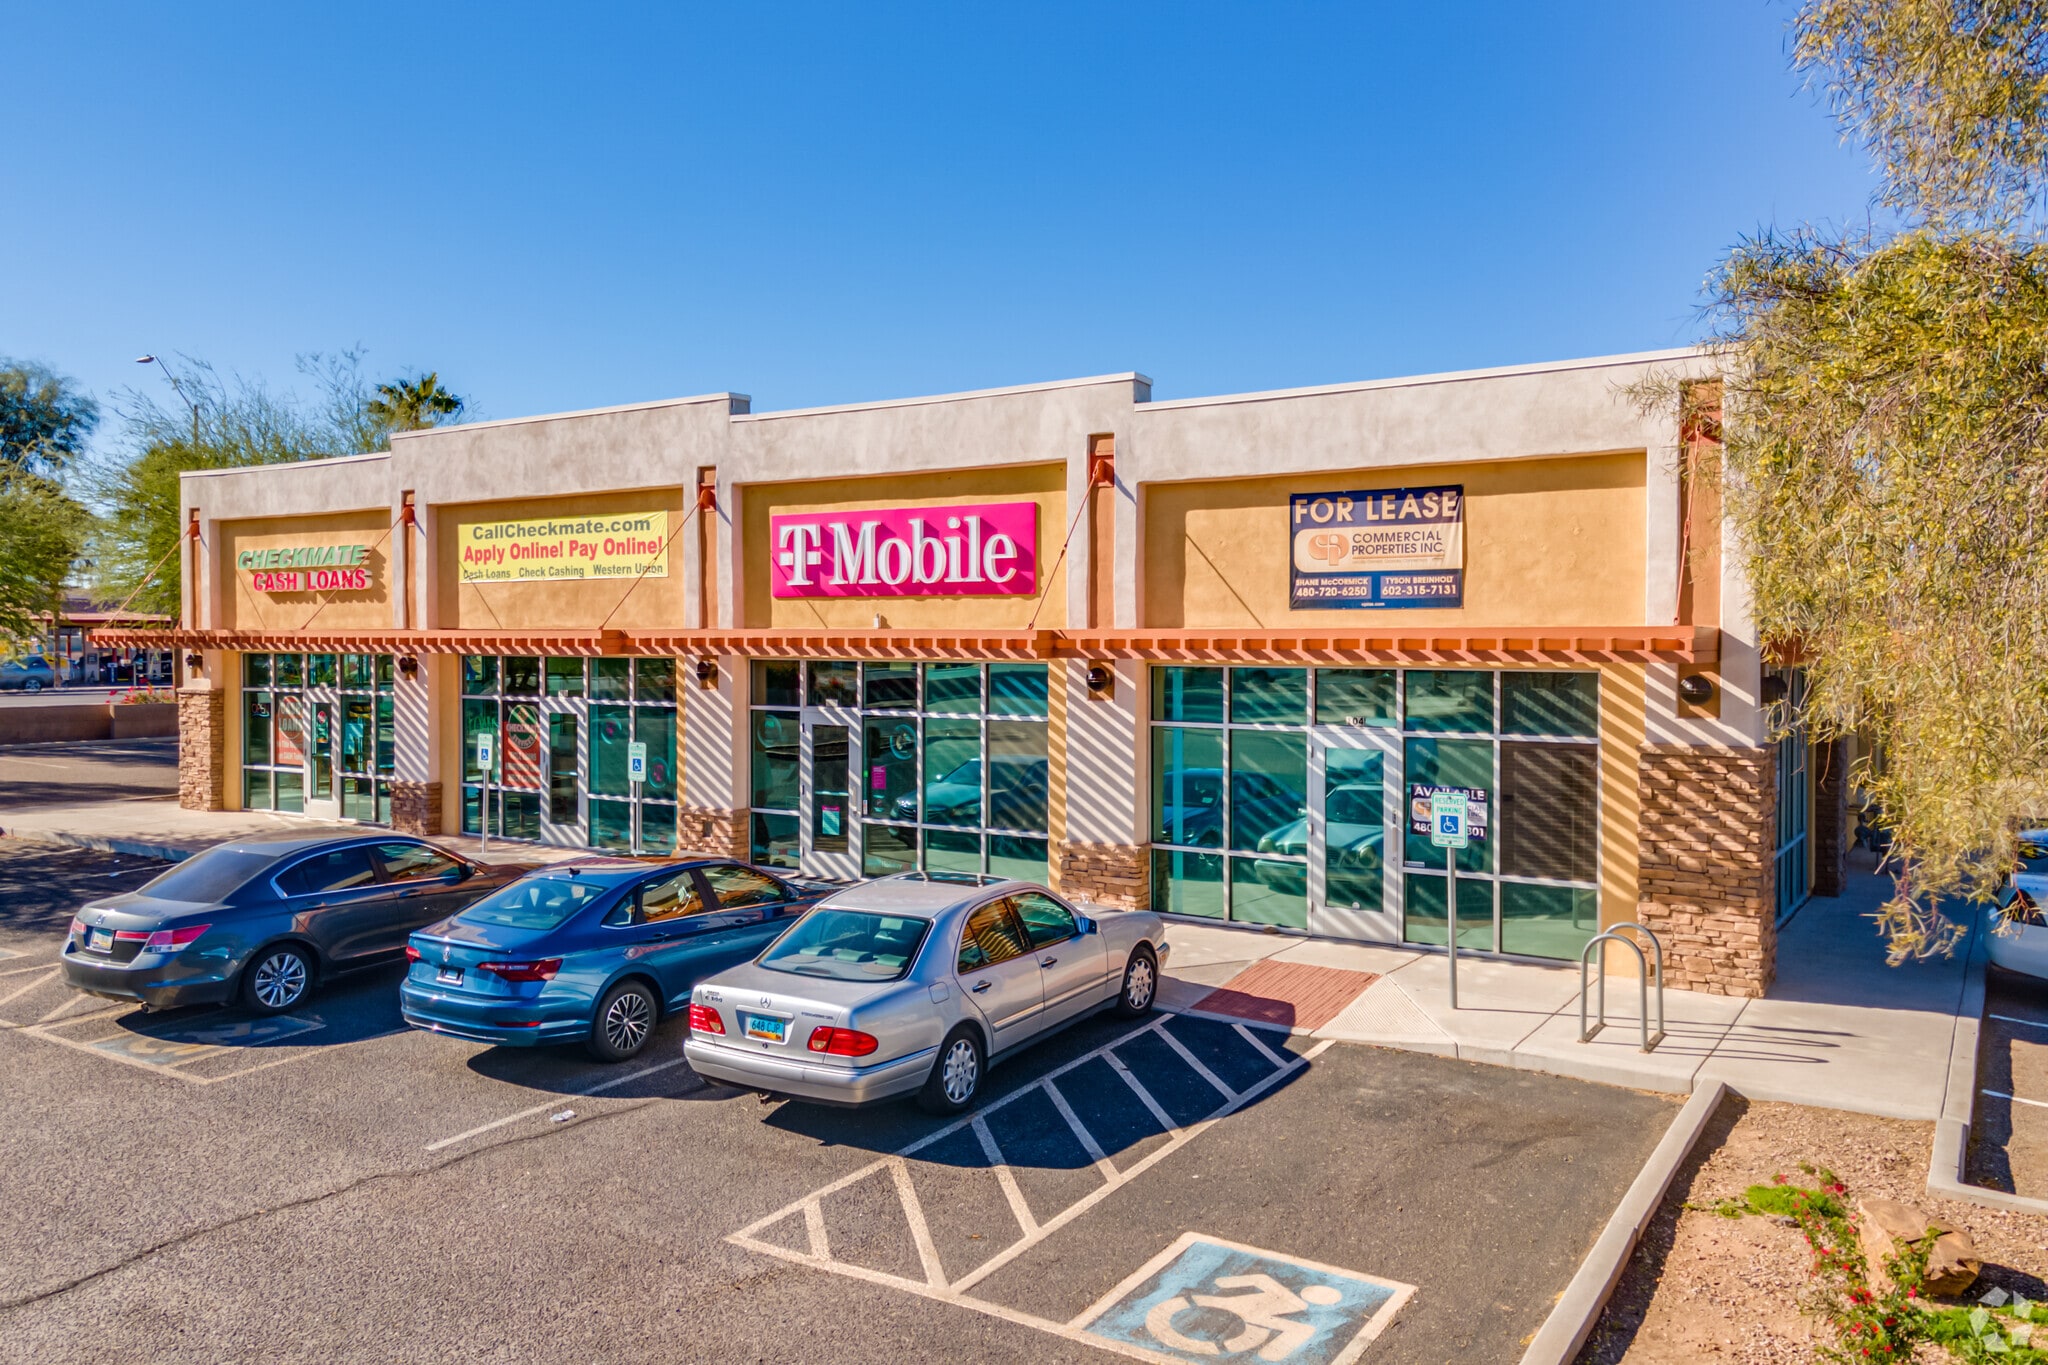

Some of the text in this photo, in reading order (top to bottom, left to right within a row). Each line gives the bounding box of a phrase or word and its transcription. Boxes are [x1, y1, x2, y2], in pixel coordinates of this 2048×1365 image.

[1295, 491, 1457, 523] FOR LEASE
[472, 519, 651, 540] CallCheckmate.com
[1352, 531, 1442, 543] COMMERCIAL
[463, 536, 663, 565] Apply Online! Pay Online!
[1351, 543, 1417, 555] PROPERTIES
[237, 544, 367, 571] CHECKMATE
[463, 563, 663, 579] Cash Loans Check Cashing Western Union
[253, 569, 366, 592] CASH LOANS
[1320, 577, 1369, 586] McCORMICK
[1296, 586, 1367, 597] 480-720-6250
[1382, 584, 1456, 595] 602-315-7131
